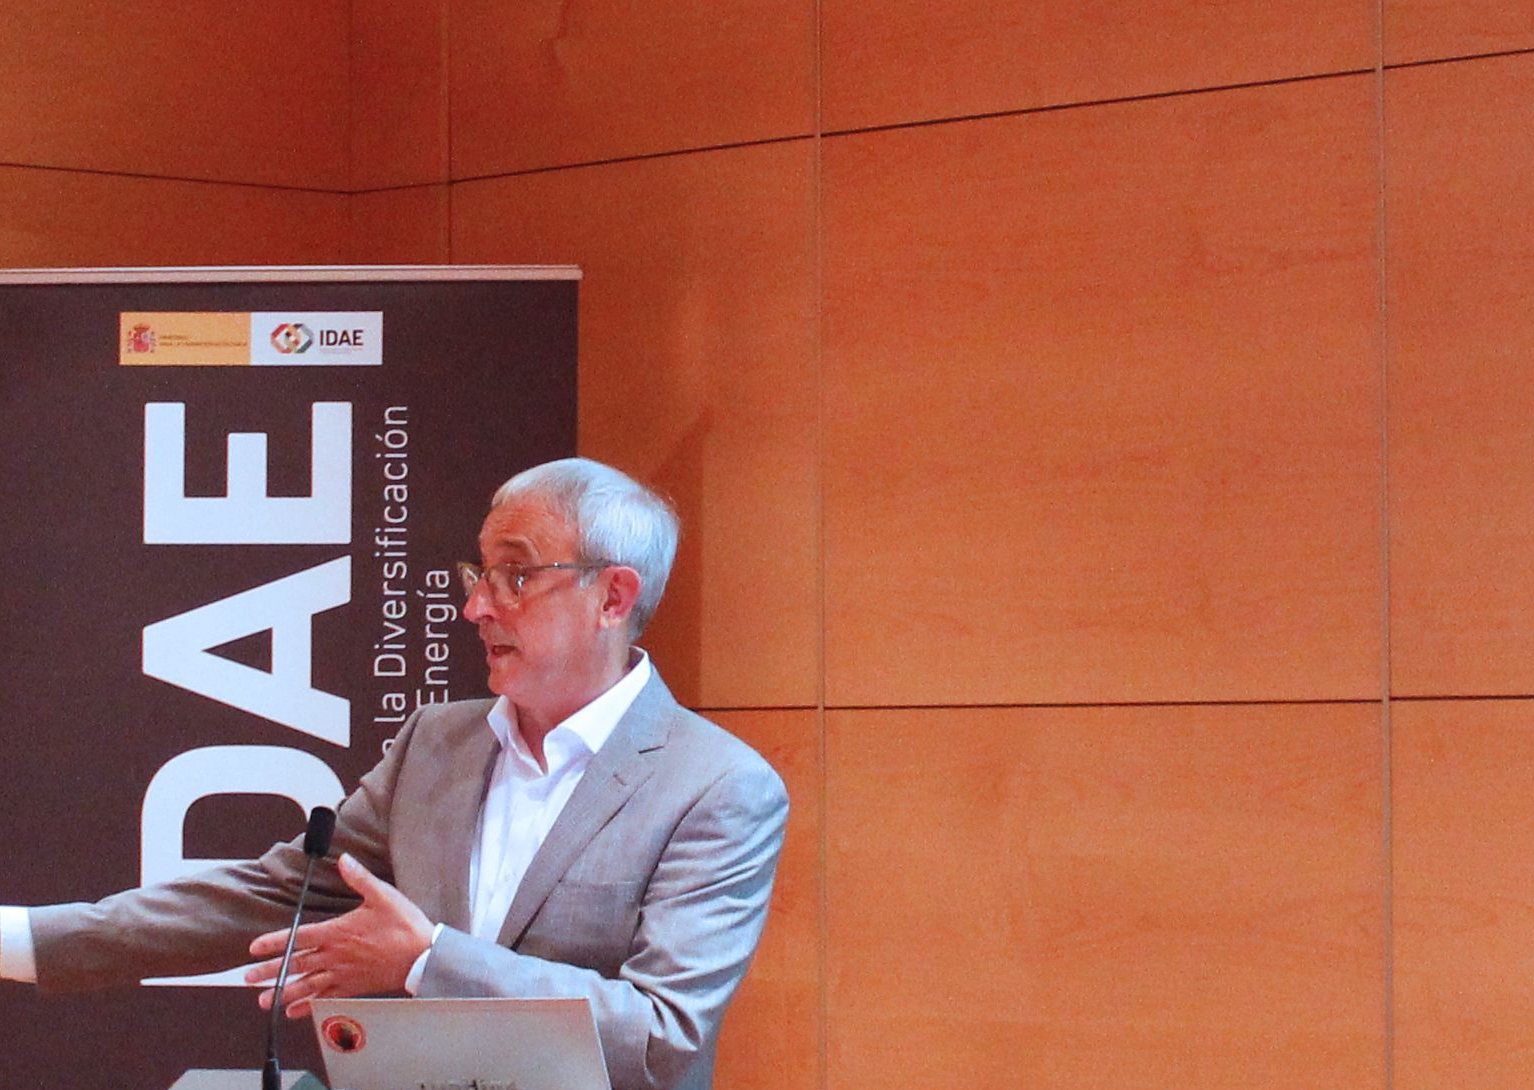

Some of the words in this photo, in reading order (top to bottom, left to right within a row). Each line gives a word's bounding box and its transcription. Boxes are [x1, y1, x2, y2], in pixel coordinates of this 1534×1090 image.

[319, 330, 364, 346] IDAE
[374, 406, 409, 677] Diversificación
[416, 569, 458, 708] Energía
[374, 692, 406, 723] la
